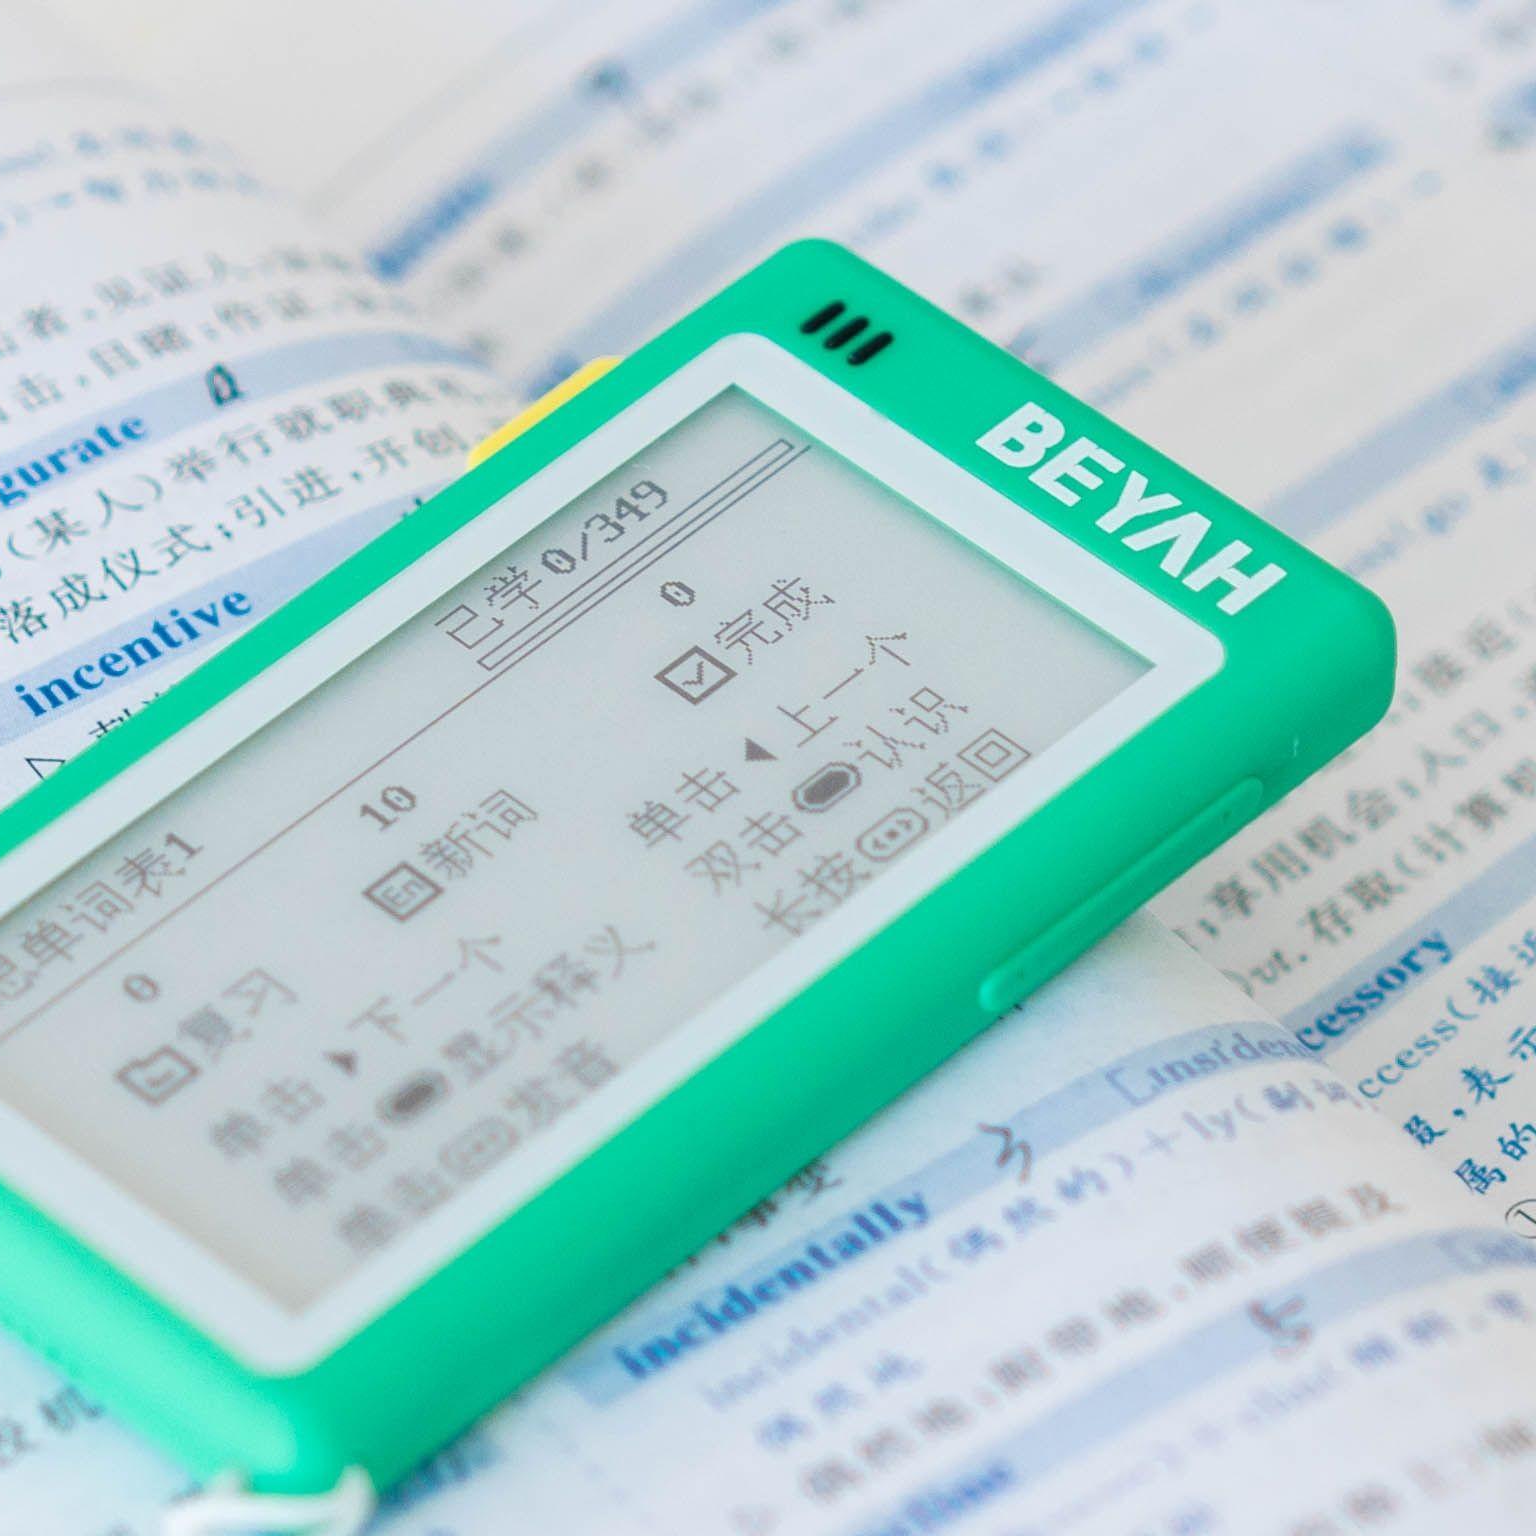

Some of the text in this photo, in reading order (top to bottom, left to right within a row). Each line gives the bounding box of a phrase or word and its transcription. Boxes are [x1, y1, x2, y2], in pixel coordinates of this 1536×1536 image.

[975, 400, 1289, 616] BEYAH
[14, 586, 254, 720] incentive
[714, 575, 837, 665] 完成
[359, 783, 418, 832] 10
[419, 787, 540, 884] 新词
[683, 806, 806, 897] 双击
[1296, 929, 1458, 1051] cessory
[613, 1193, 932, 1381] incidentally
